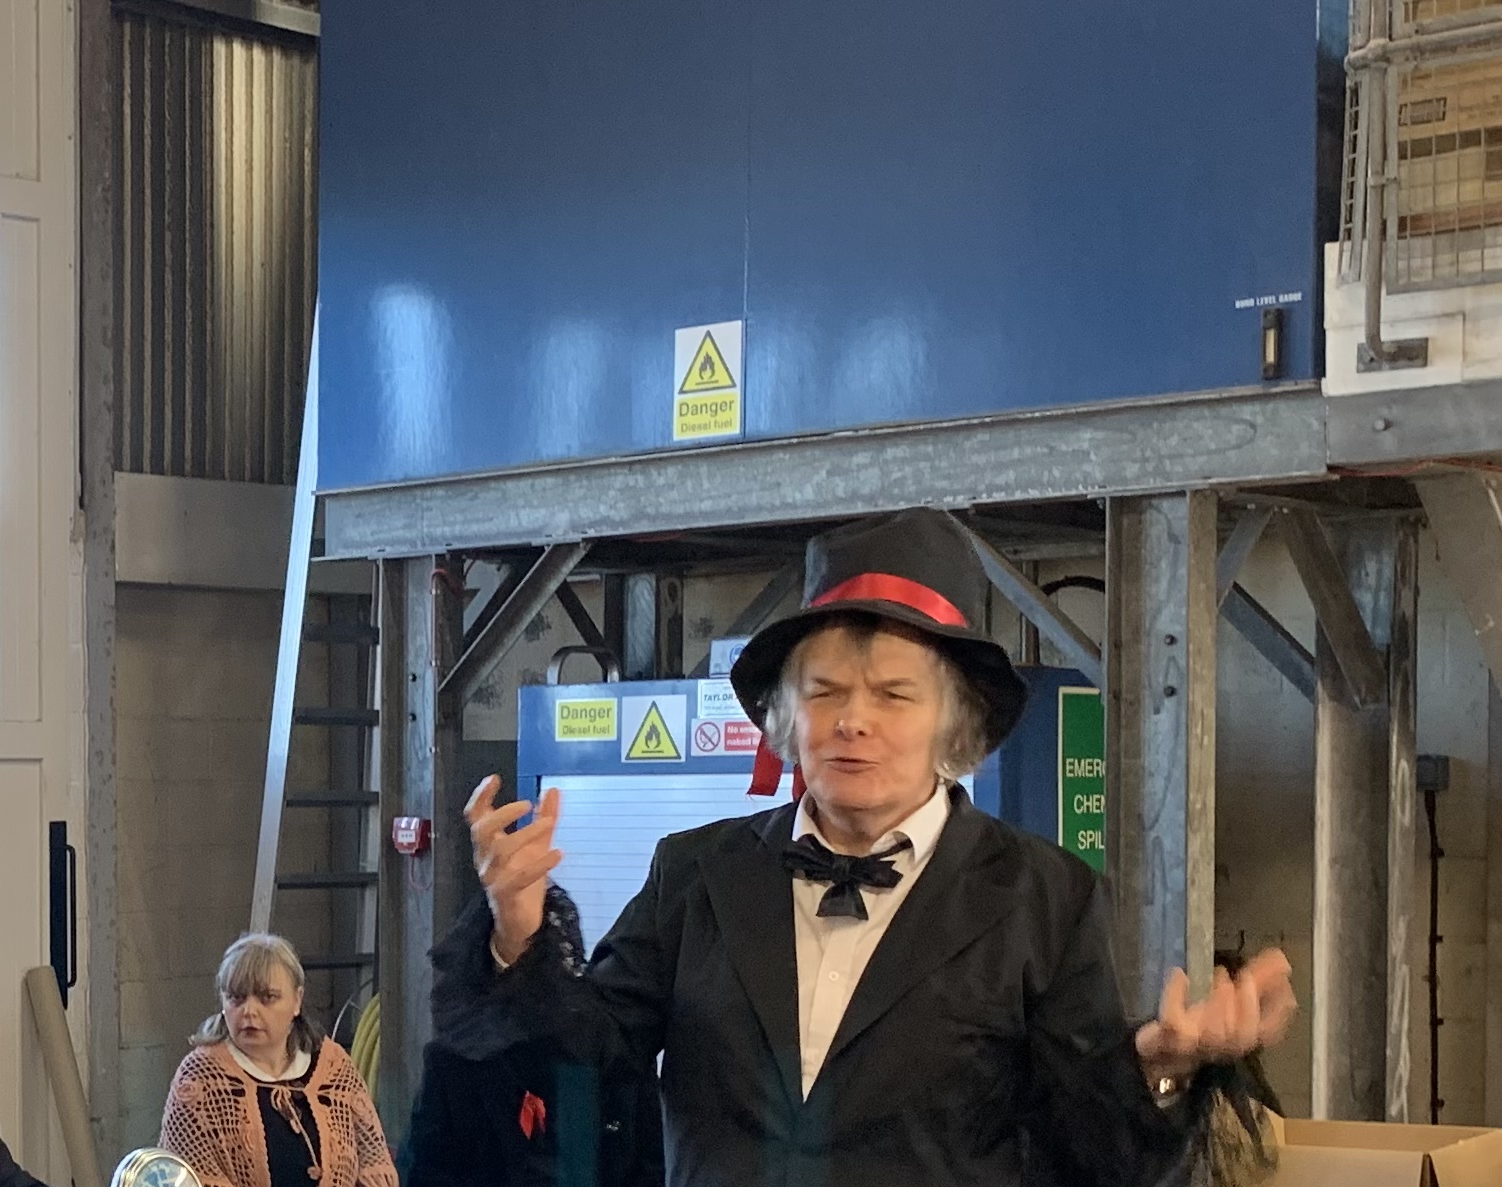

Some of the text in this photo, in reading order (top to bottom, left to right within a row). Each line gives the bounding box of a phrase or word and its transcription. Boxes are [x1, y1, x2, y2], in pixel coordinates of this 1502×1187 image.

[679, 400, 734, 417] Danger
[681, 419, 733, 433] Diesel fuel
[704, 693, 734, 702] TAYLOR
[560, 705, 612, 722] Danger
[562, 725, 610, 735] Diesel fuel
